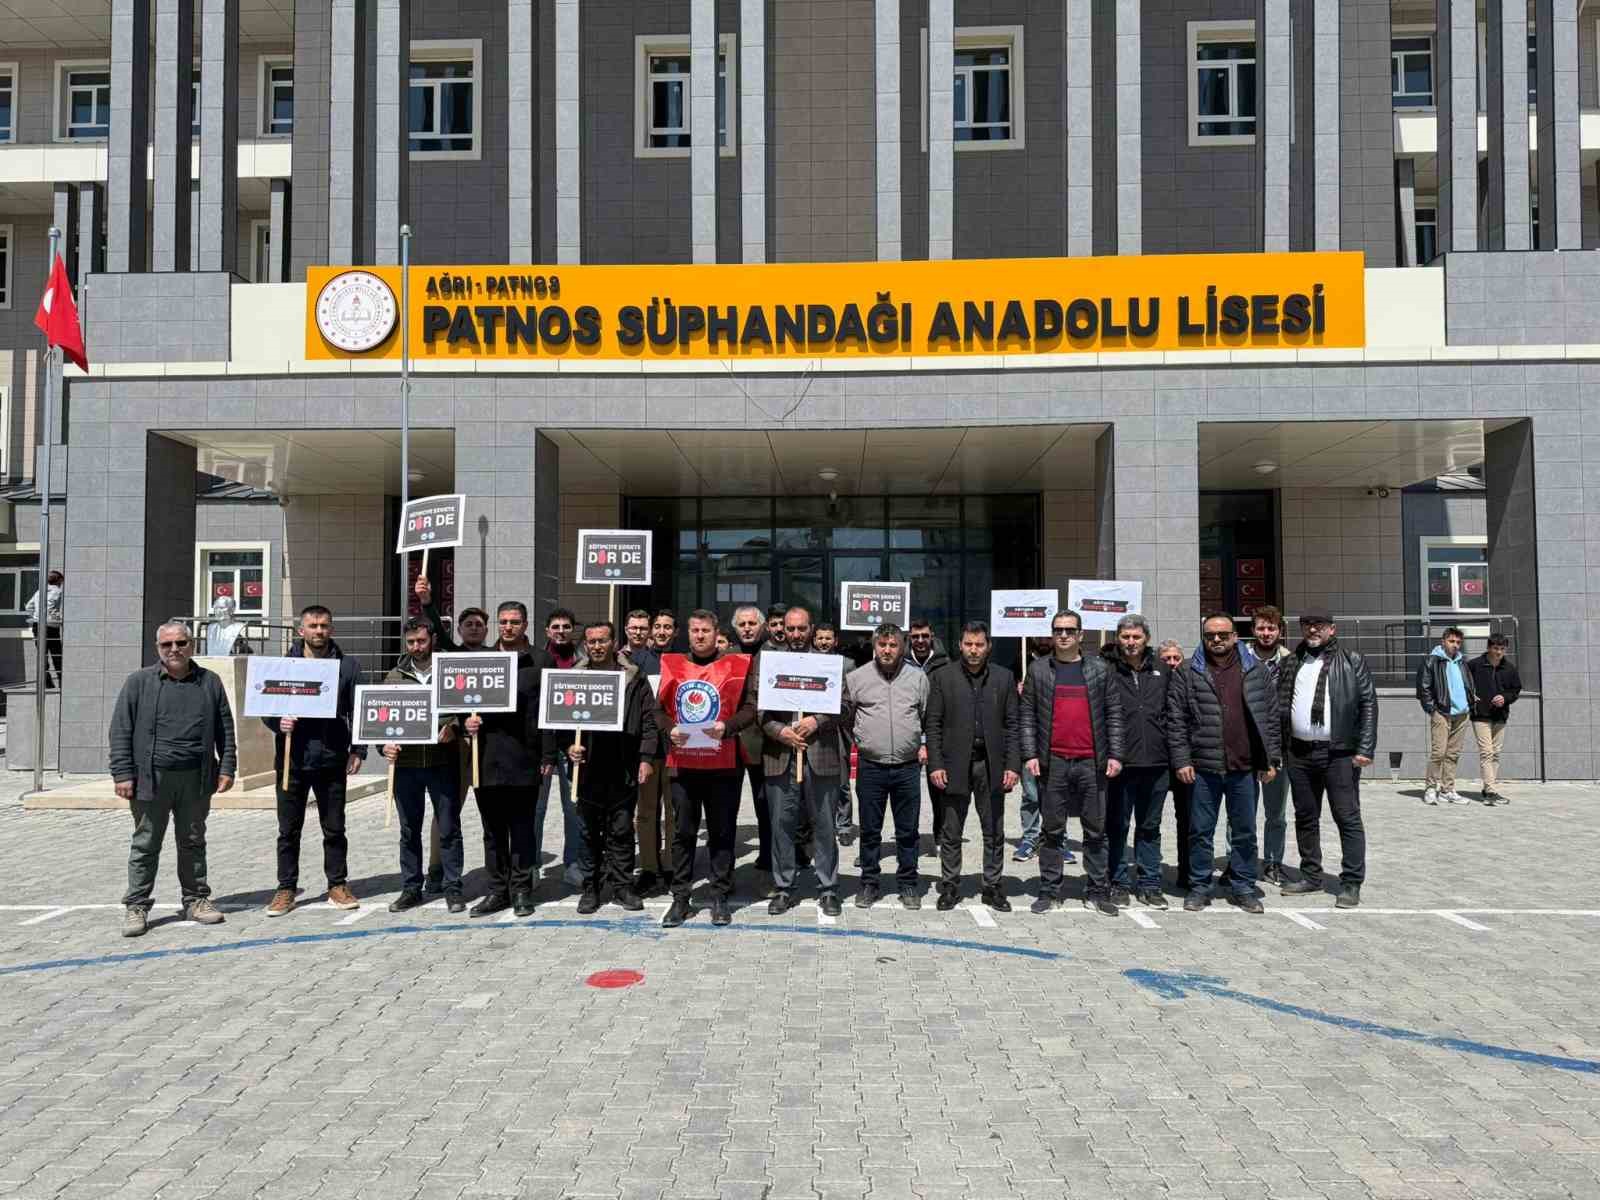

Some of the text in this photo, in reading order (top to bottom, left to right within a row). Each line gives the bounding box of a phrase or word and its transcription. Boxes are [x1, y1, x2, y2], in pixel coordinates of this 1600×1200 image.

[426, 272, 472, 295] AĞRI
[486, 276, 560, 296] PATNOS
[423, 305, 602, 346] PATNOS
[616, 291, 912, 346] SÜPHANDAĞI
[928, 297, 1160, 342] ANADOLU
[1177, 283, 1325, 336] LİSESİ
[435, 513, 456, 527] DE
[621, 551, 642, 564] DE
[883, 601, 902, 612] DE
[482, 675, 505, 689] DE
[592, 692, 614, 706] DE
[405, 708, 428, 721] DE
